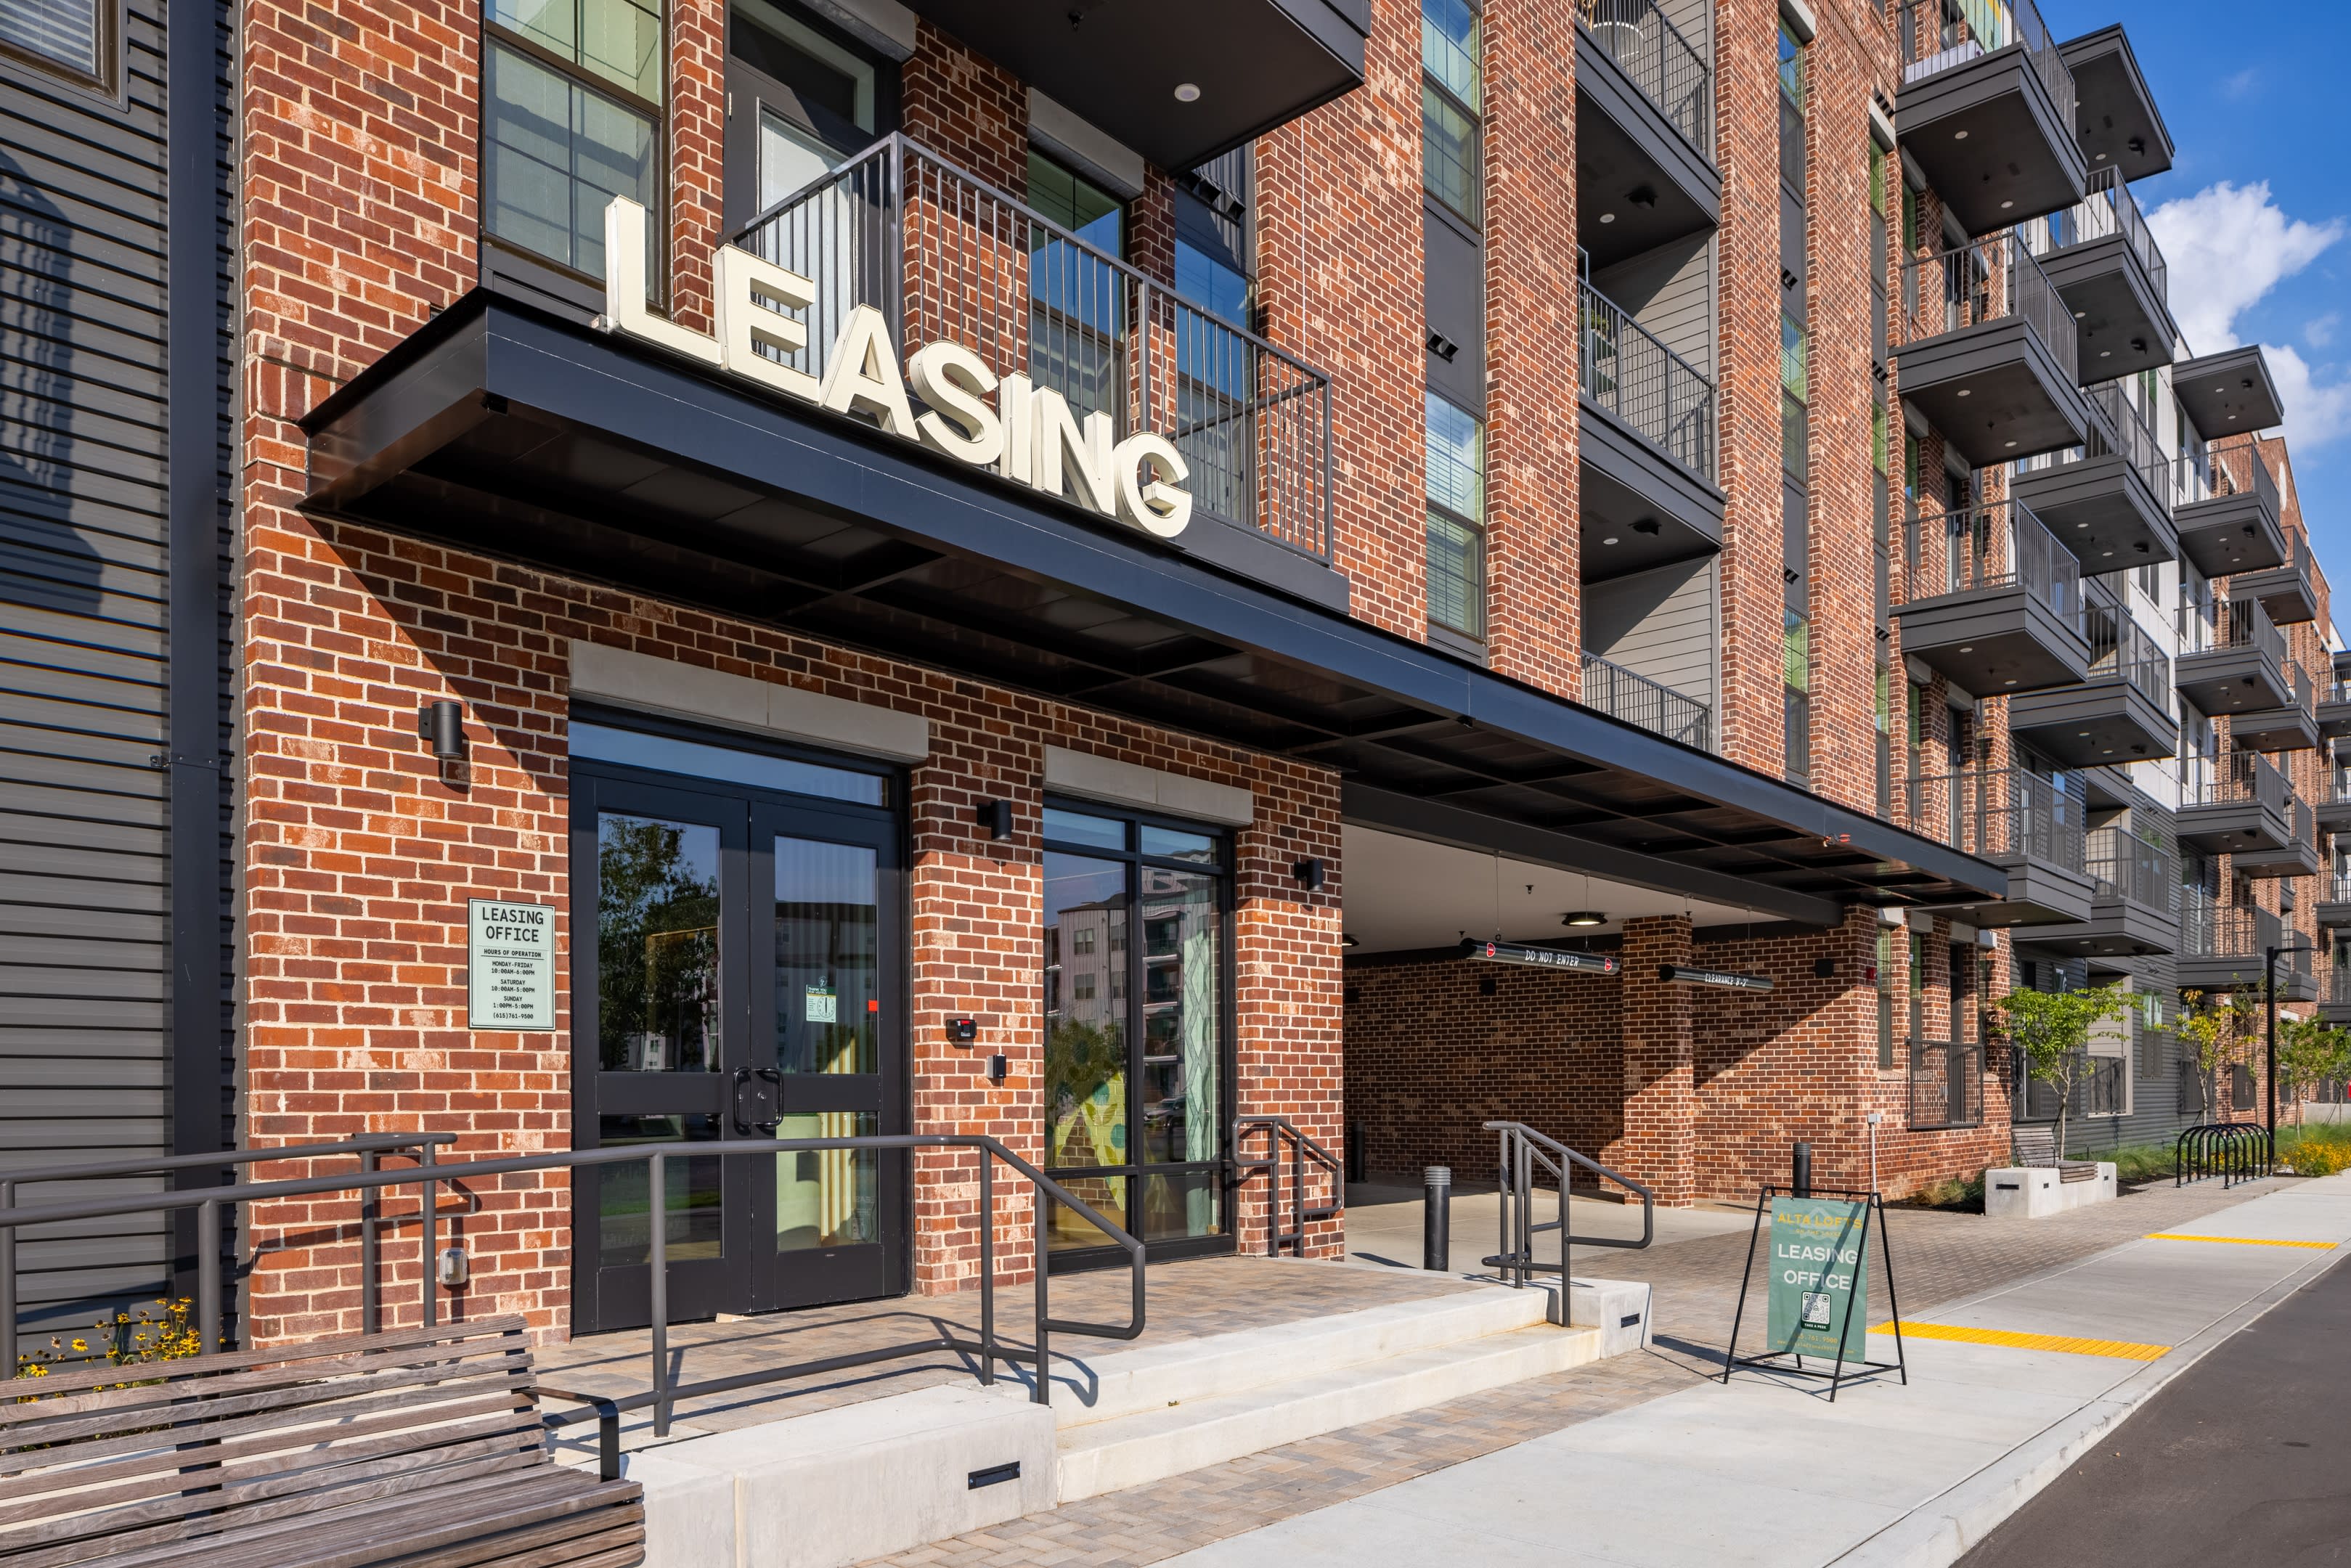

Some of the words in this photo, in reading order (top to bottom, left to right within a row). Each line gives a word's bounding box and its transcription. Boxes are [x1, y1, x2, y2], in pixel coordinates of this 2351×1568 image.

[605, 195, 1192, 539] LEASING
[482, 907, 544, 925] LEASING
[486, 926, 539, 942] OFFICE
[1525, 950, 1536, 961] DO
[1539, 952, 1553, 963] NOT
[1556, 954, 1579, 967] ENTER
[1705, 973, 1734, 985] CLEARANCE
[1777, 1212, 1811, 1225] ALTA
[1815, 1215, 1862, 1229] LOFTS
[1778, 1244, 1858, 1265] LEASING
[1783, 1270, 1851, 1290] OFFICE
[1795, 1333, 1838, 1344] 5.761.9500
